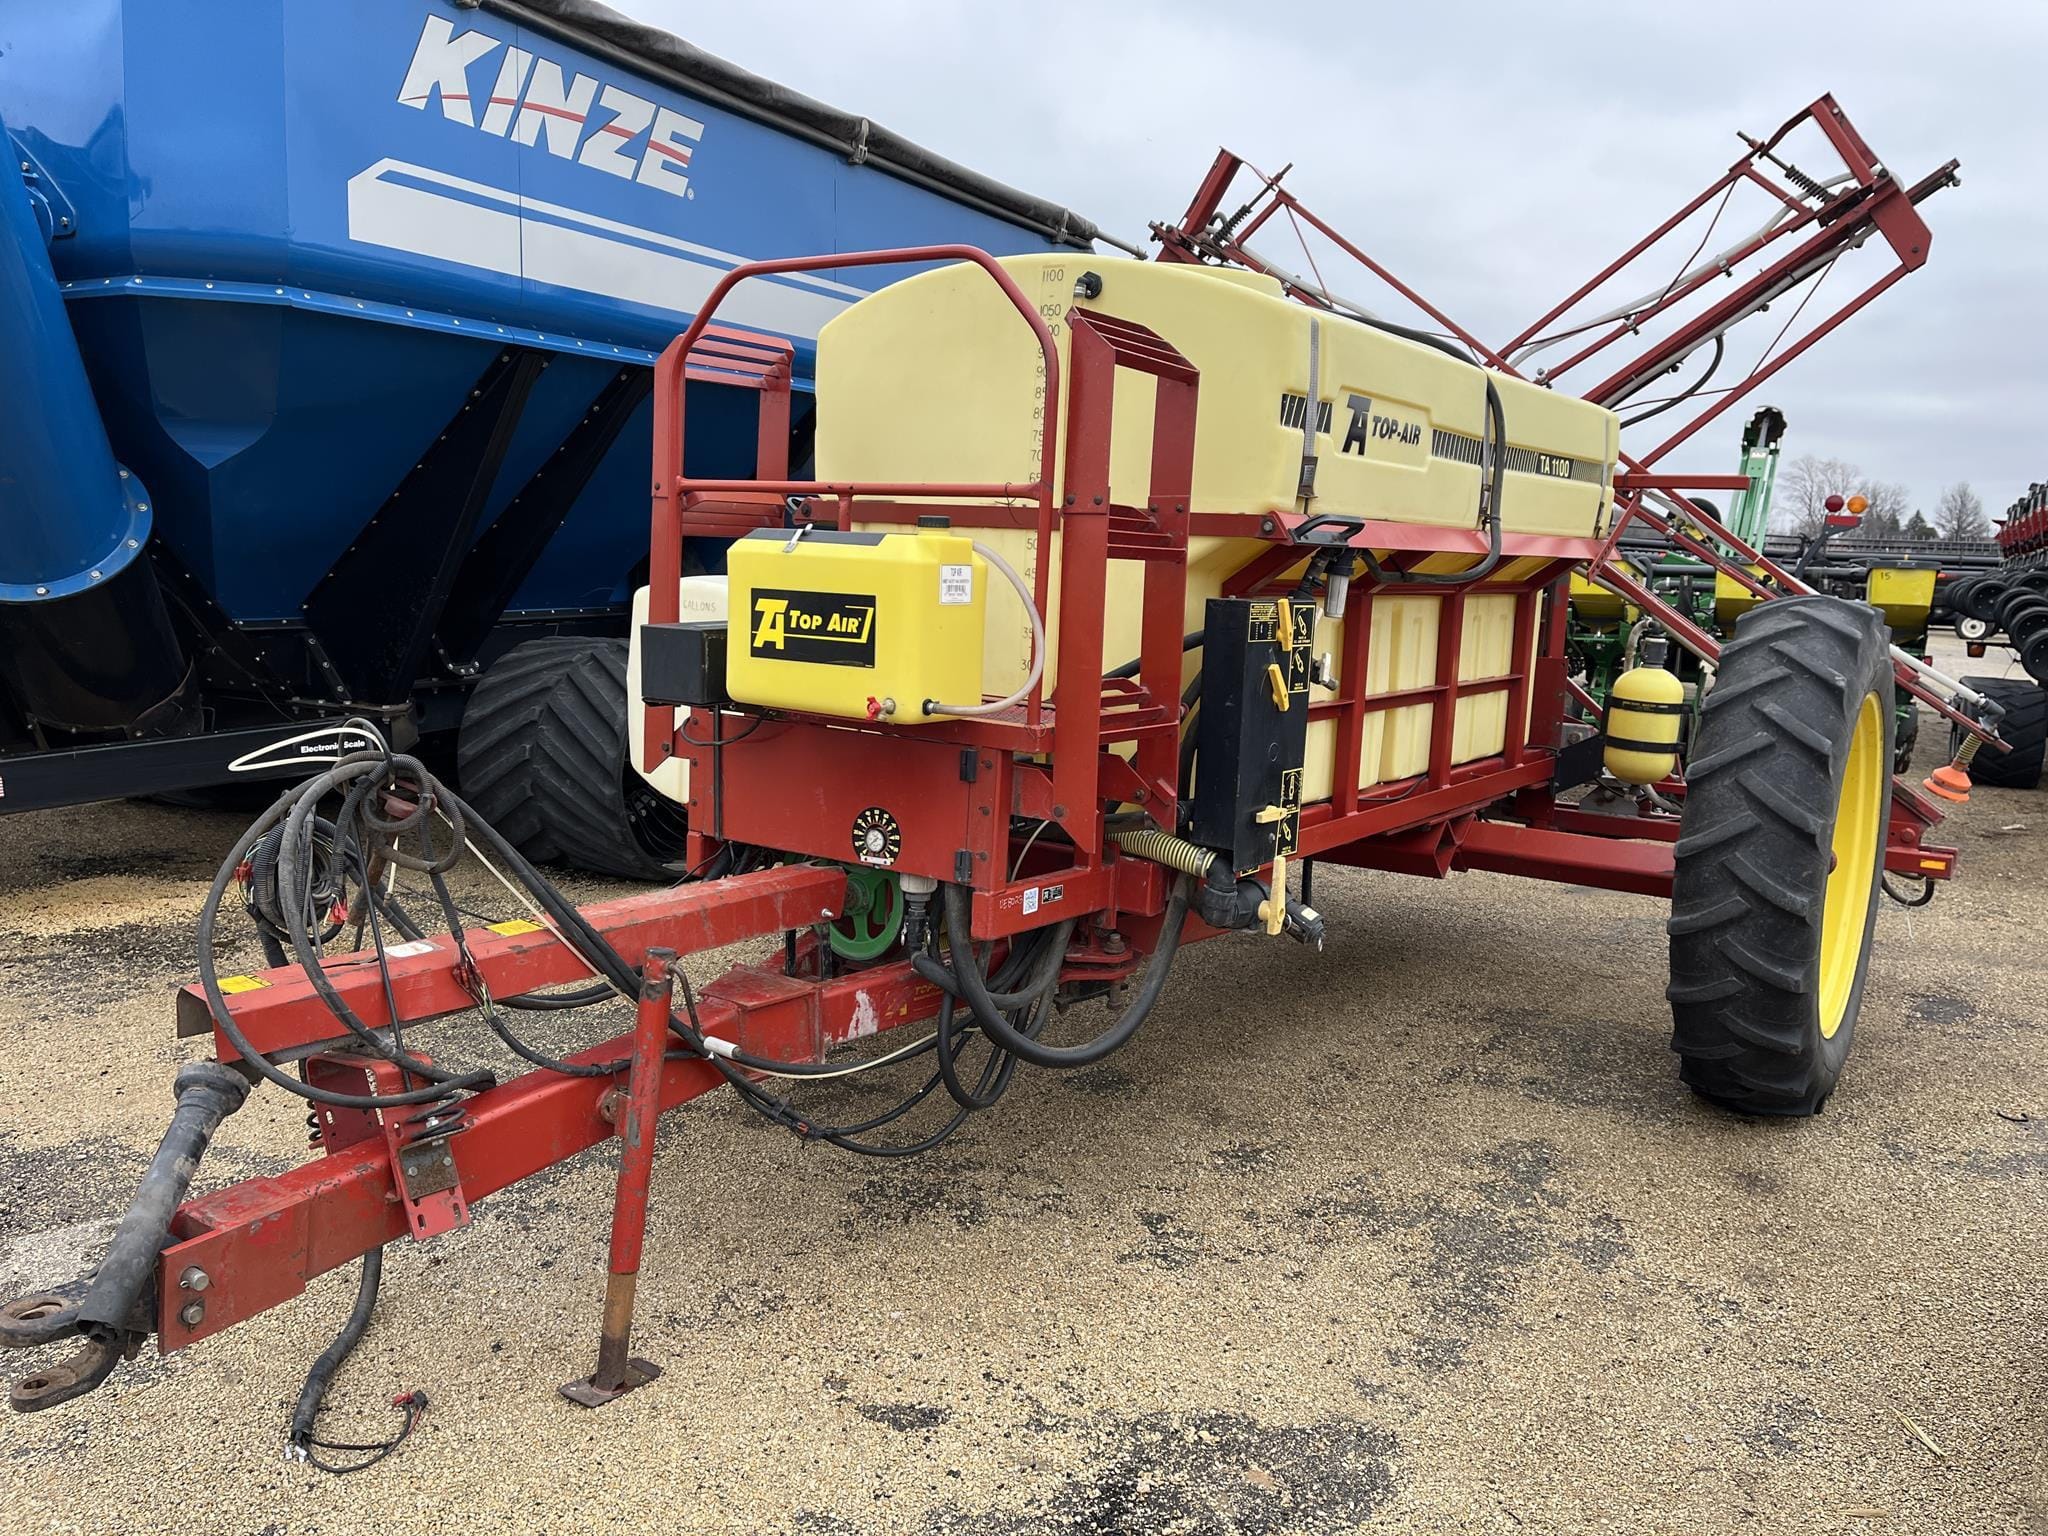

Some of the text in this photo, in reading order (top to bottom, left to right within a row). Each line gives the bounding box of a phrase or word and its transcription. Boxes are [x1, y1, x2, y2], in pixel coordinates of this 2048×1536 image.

[397, 13, 705, 198] KINZE
[1042, 268, 1064, 283] 1100
[1040, 303, 1062, 317] 1050
[1372, 415, 1422, 446] TOP-AIR
[1540, 455, 1570, 478] TA 1100
[1880, 571, 1892, 581] 15
[789, 609, 823, 630] TOP
[827, 613, 859, 633] AIR
[300, 738, 366, 754] Electronic Scale
